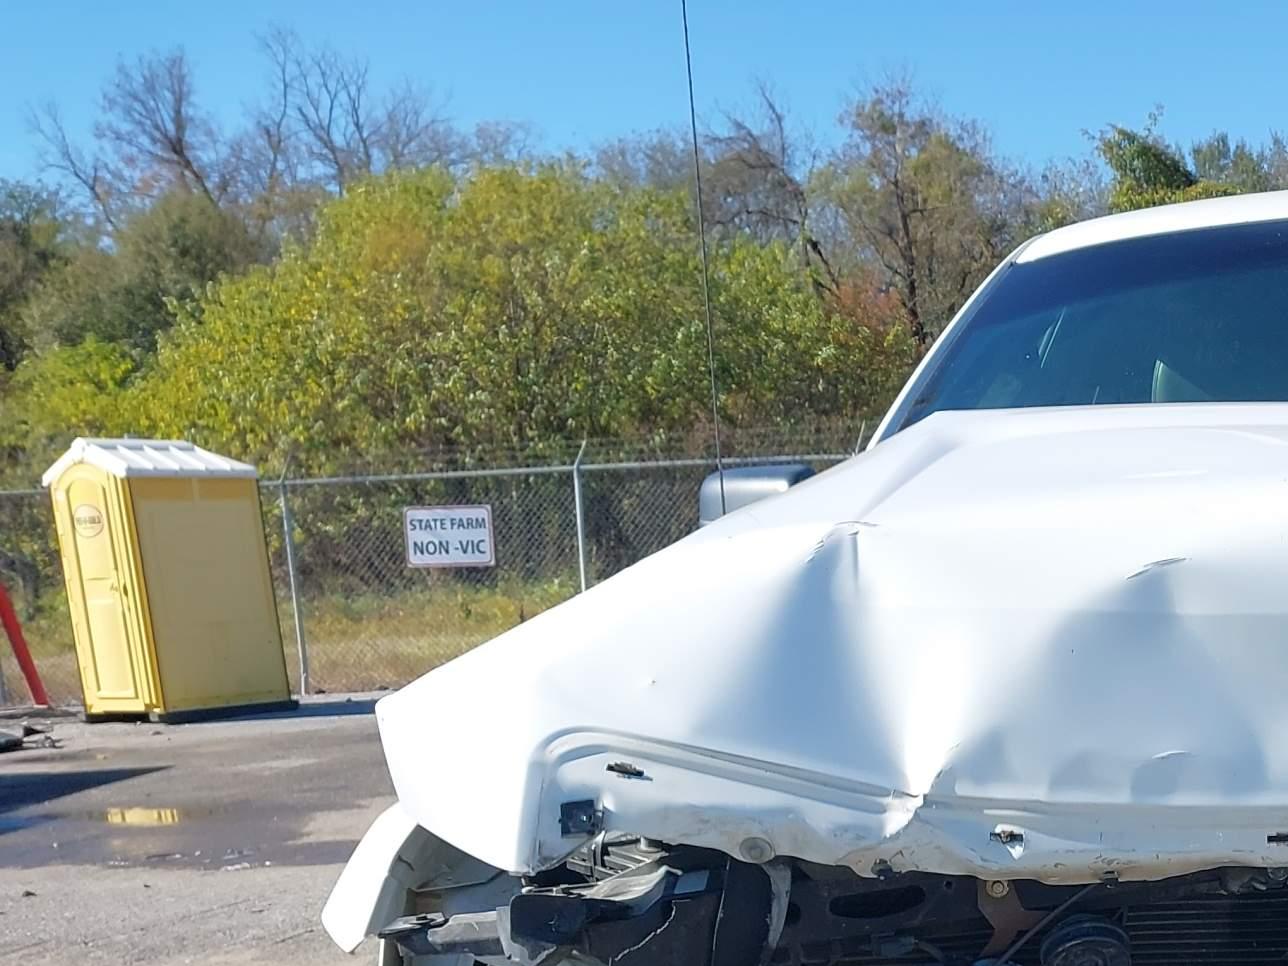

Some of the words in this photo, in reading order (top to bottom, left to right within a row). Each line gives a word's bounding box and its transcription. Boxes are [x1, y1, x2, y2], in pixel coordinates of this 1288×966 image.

[410, 518, 447, 531] STATE
[450, 517, 486, 530] FARM
[413, 540, 450, 556] NON
